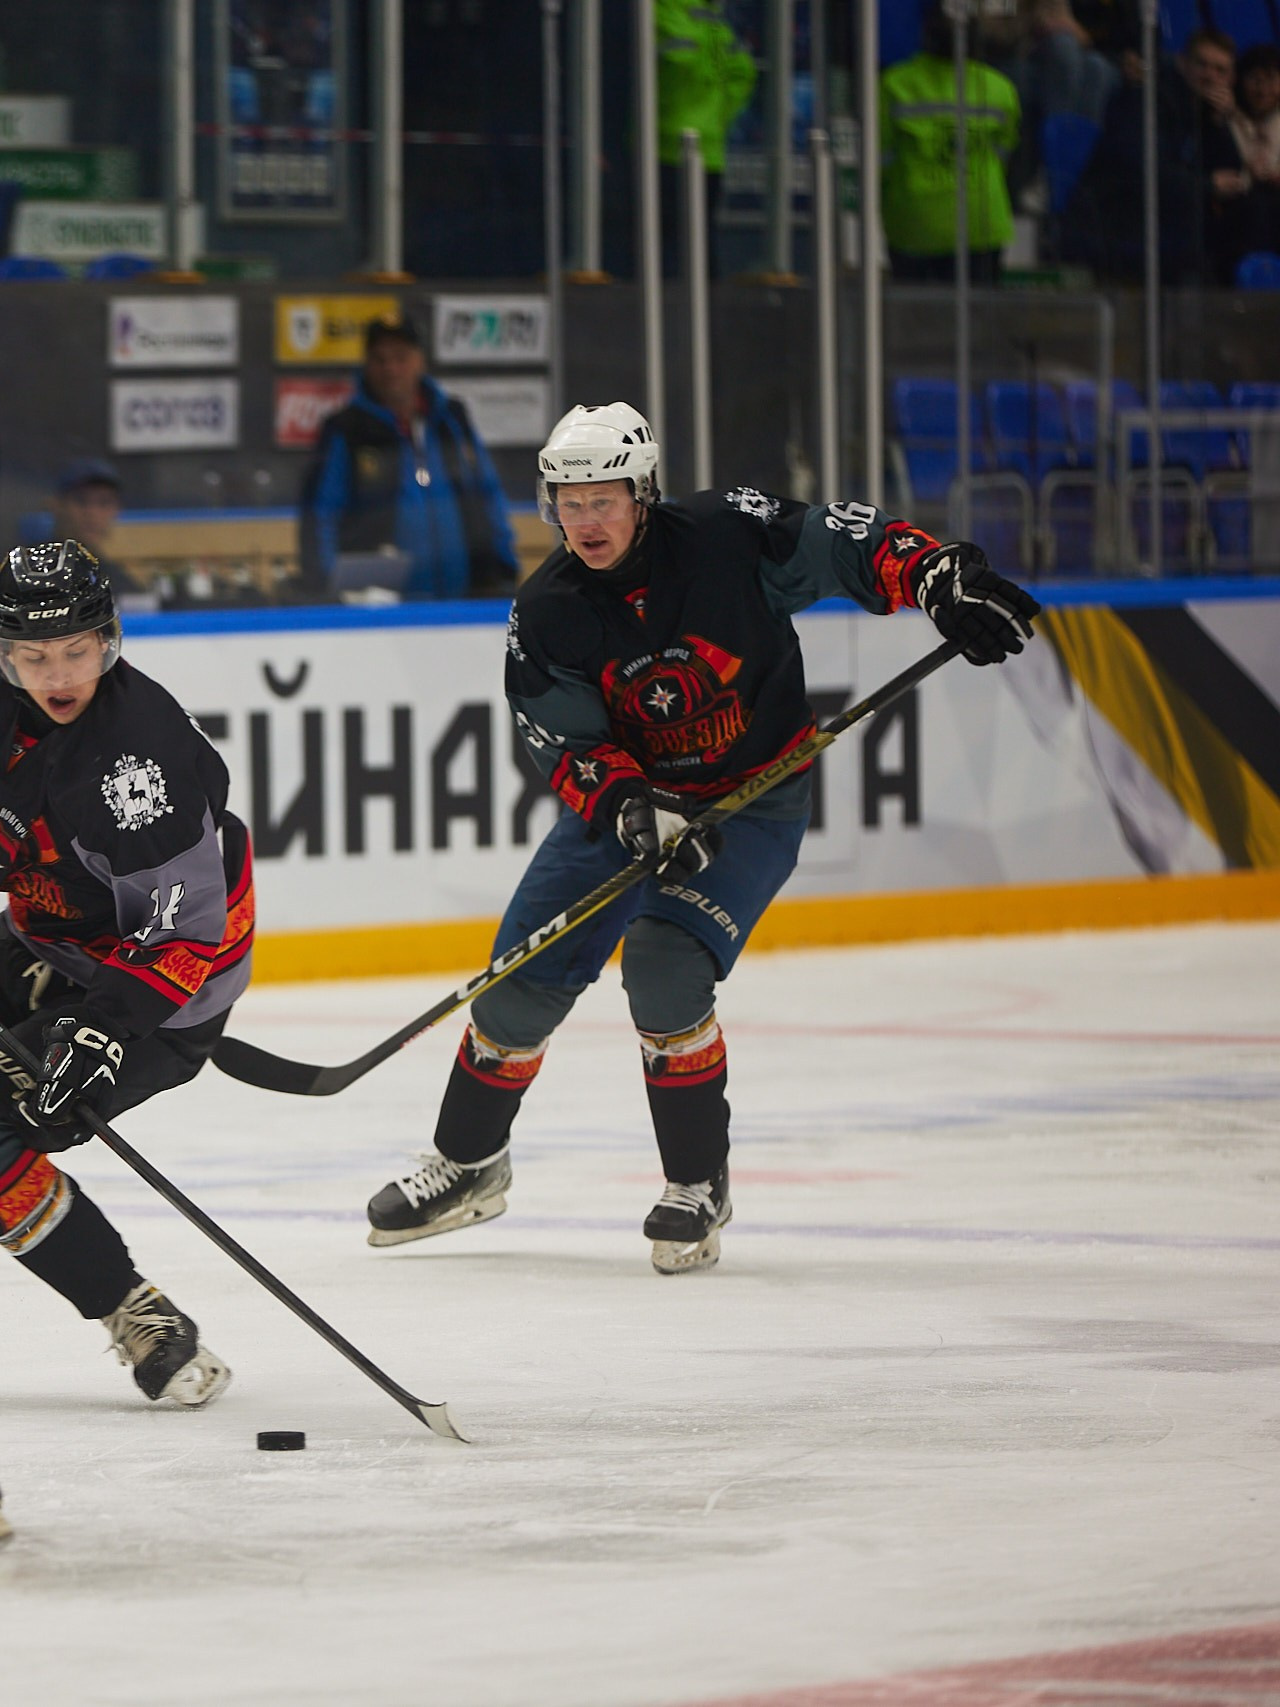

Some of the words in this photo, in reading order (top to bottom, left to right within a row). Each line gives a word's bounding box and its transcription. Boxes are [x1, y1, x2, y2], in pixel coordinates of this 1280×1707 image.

[562, 458, 593, 467] Reebok
[27, 606, 70, 621] CCM
[732, 739, 817, 801] TACKS
[456, 911, 567, 1001] CCM
